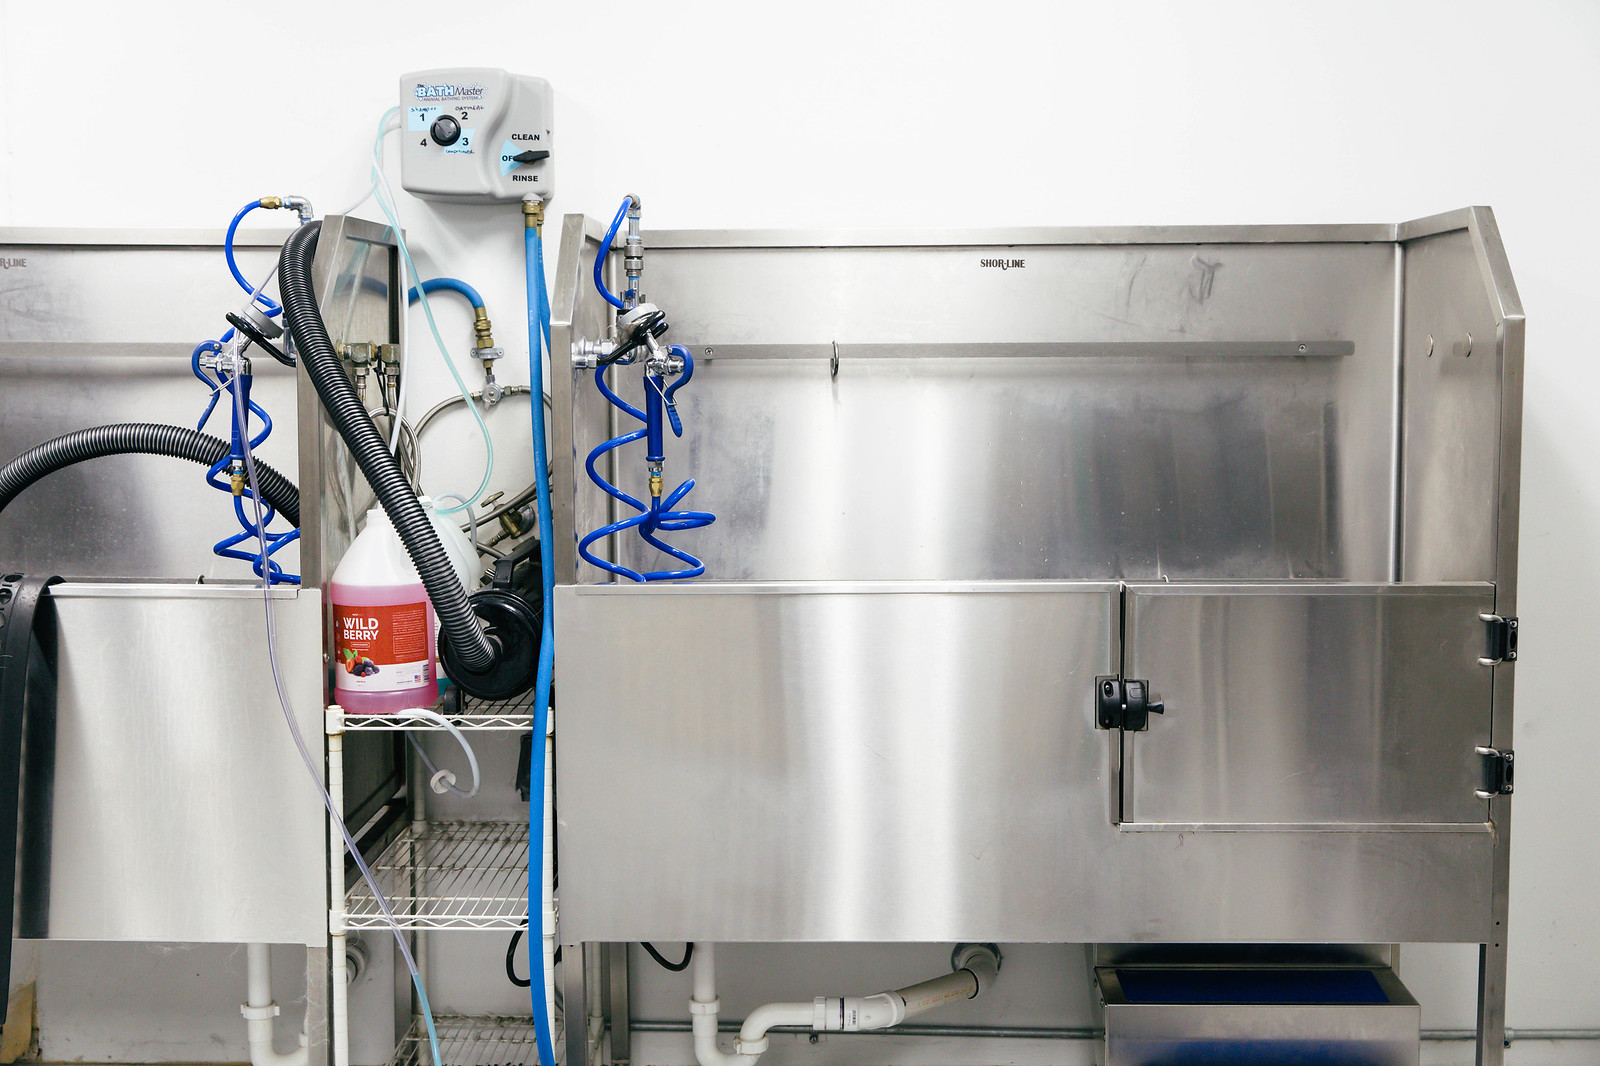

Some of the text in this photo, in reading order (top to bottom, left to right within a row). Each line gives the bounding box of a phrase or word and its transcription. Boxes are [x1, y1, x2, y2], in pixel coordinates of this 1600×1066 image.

[416, 85, 484, 97] BATH Master
[419, 113, 425, 121] 1
[461, 111, 468, 120] 2
[420, 138, 427, 147] 4
[462, 137, 469, 146] 3
[0, 258, 27, 269] R-LINE
[980, 258, 1025, 270] SHOR-LINE
[343, 617, 379, 630] WILD
[343, 629, 379, 641] BERRY
